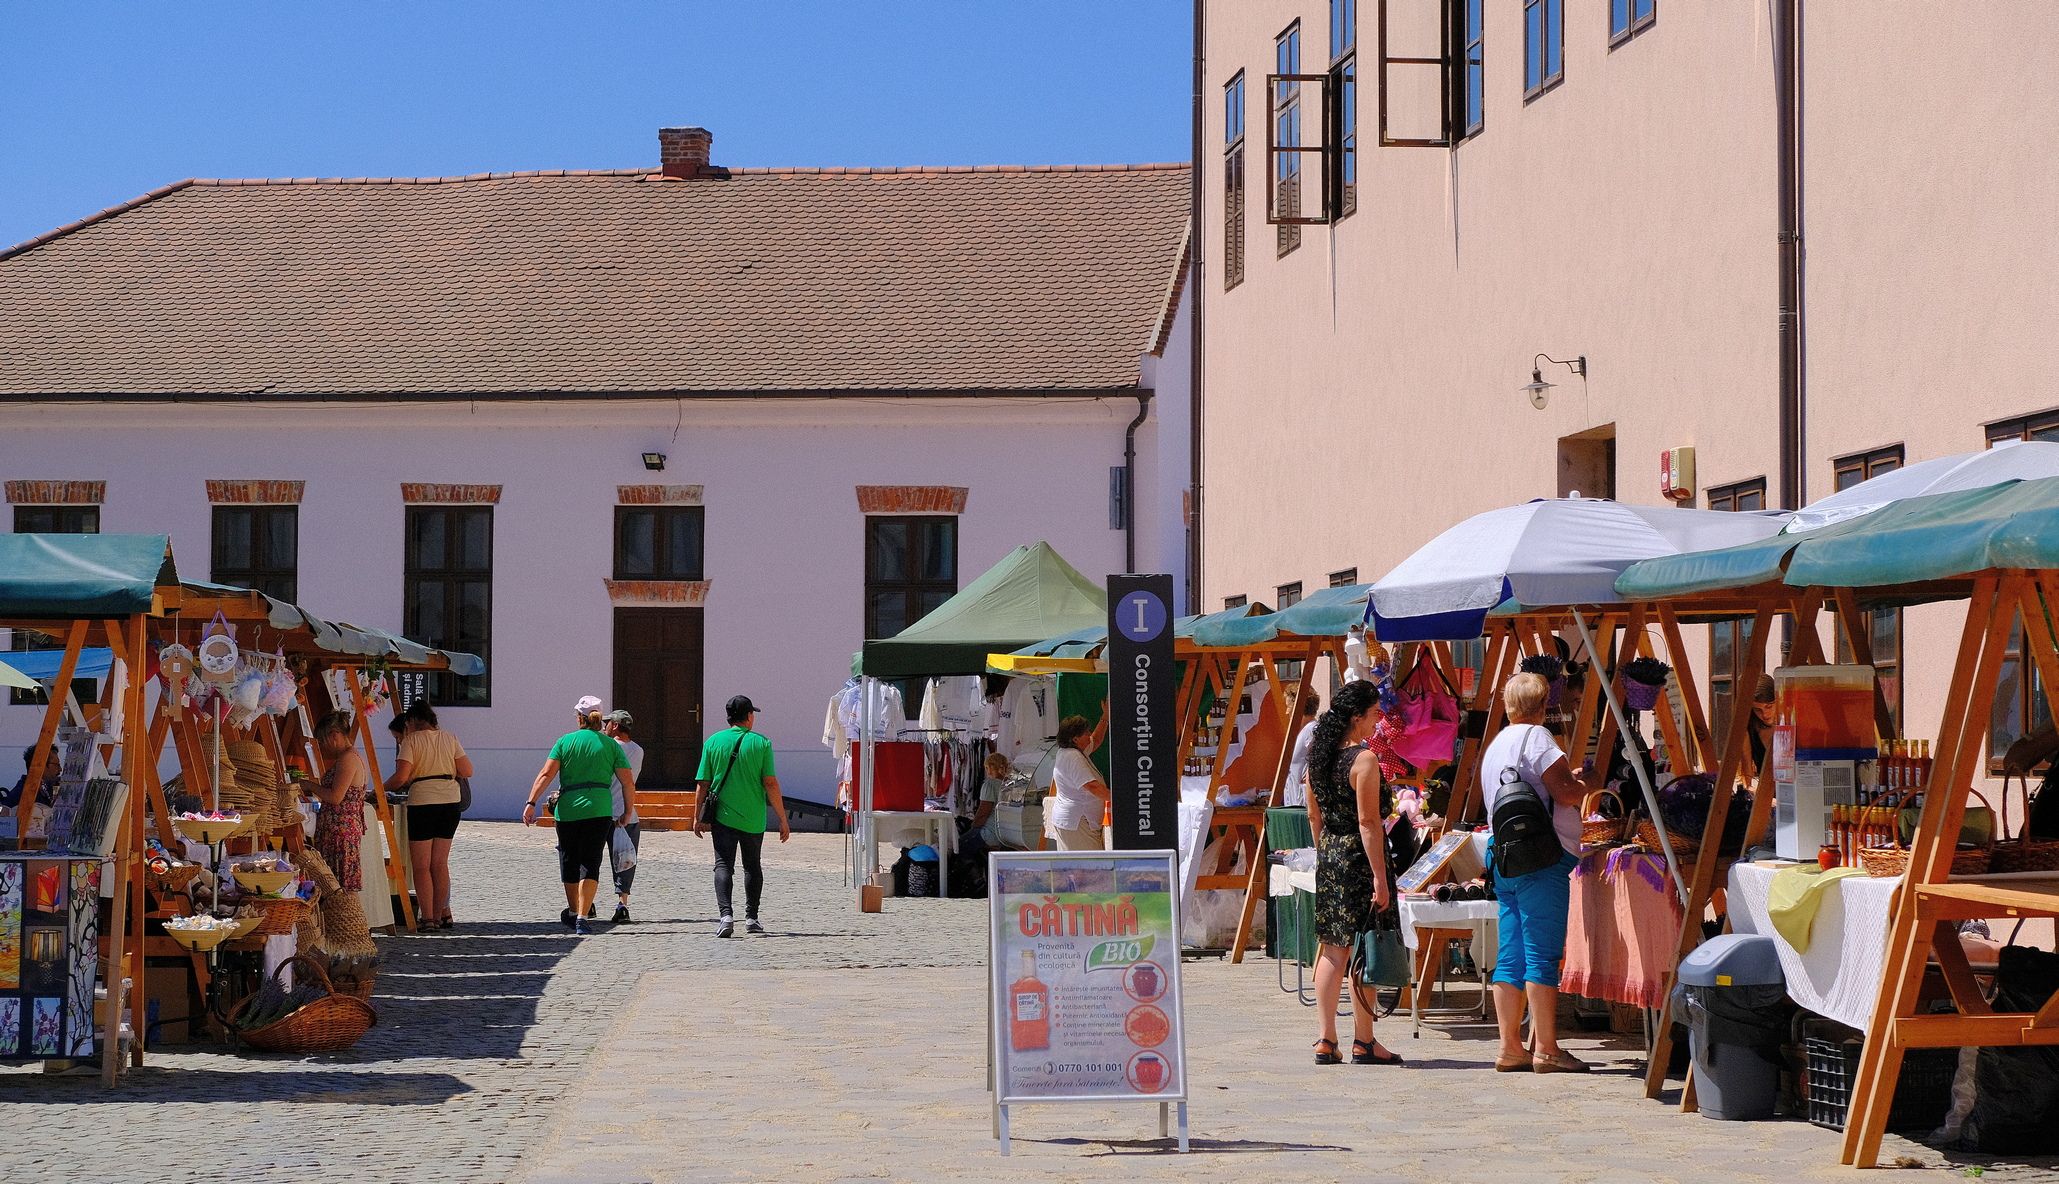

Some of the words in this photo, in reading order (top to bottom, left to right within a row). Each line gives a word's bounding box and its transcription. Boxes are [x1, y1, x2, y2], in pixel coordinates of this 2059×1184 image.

[415, 673, 423, 694] Sală
[1134, 653, 1153, 751] Consorțiu
[1137, 755, 1155, 836] Cultural
[1019, 895, 1139, 937] CĂTINĂ
[1038, 951, 1051, 960] din
[1053, 951, 1081, 960] cultură
[1102, 942, 1142, 962] BIO
[1038, 963, 1076, 971] ecologică
[1058, 1063, 1082, 1072] 0770
[1085, 1063, 1102, 1072] 101
[1105, 1063, 1123, 1072] 001
